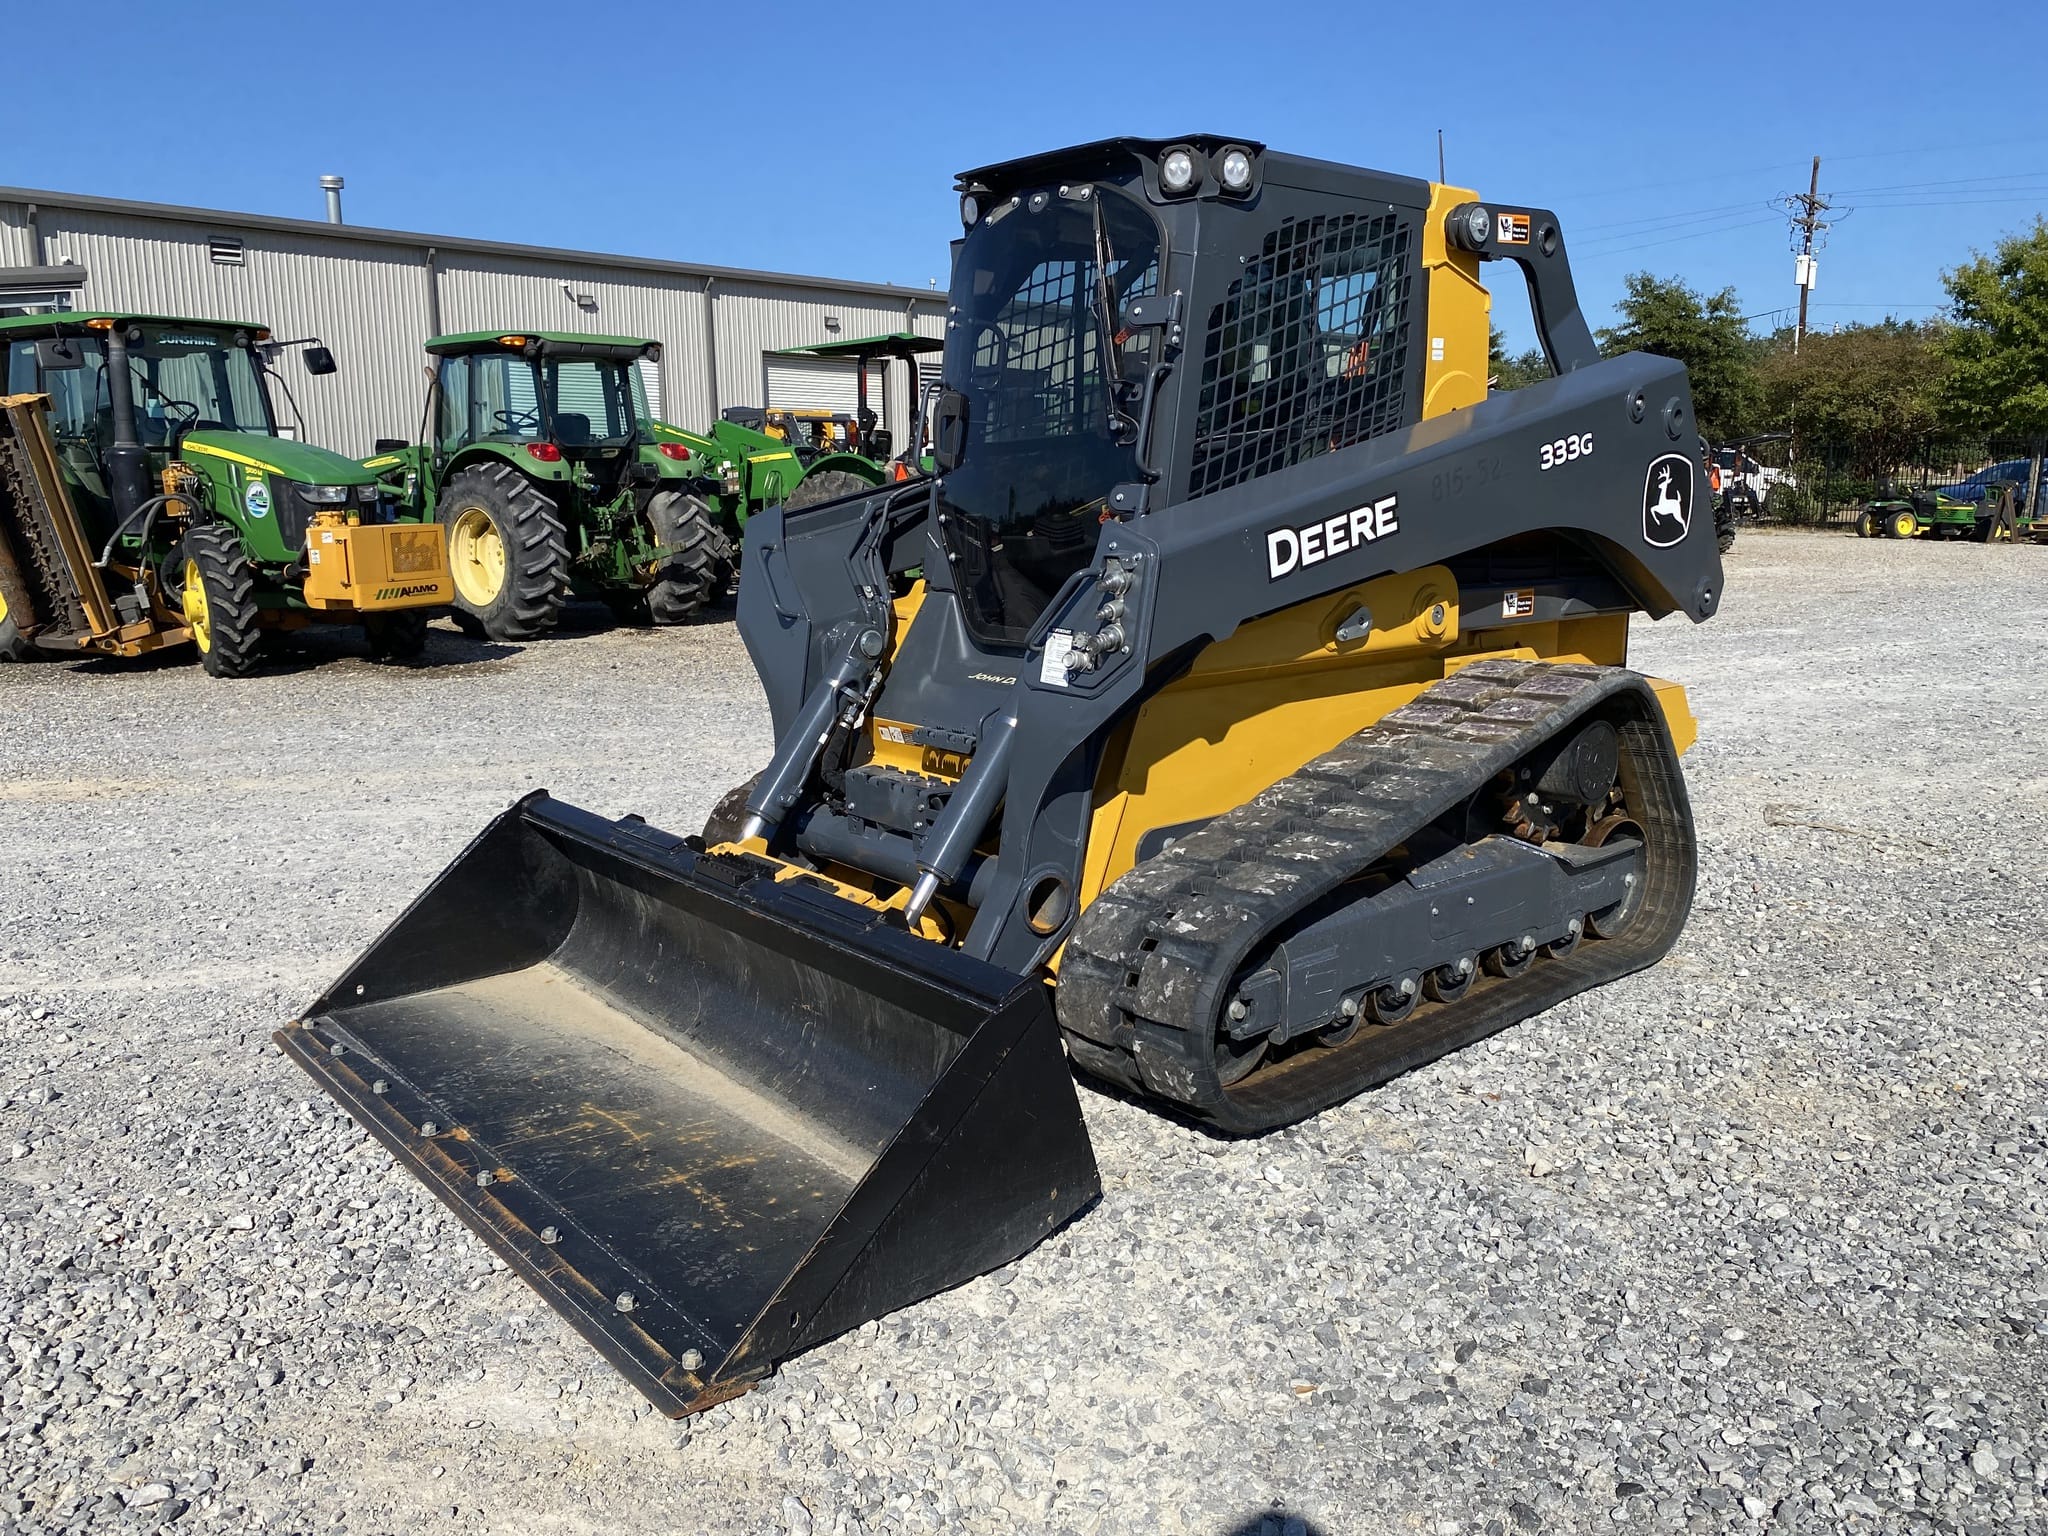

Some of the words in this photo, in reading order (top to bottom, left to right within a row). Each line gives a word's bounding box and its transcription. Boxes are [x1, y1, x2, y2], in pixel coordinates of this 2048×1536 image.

[159, 334, 217, 346] SUNSHINE
[1540, 432, 1593, 470] 333G
[1267, 495, 1398, 579] DEERE
[400, 584, 439, 598] ALAMO
[968, 672, 1003, 683] JOHN
